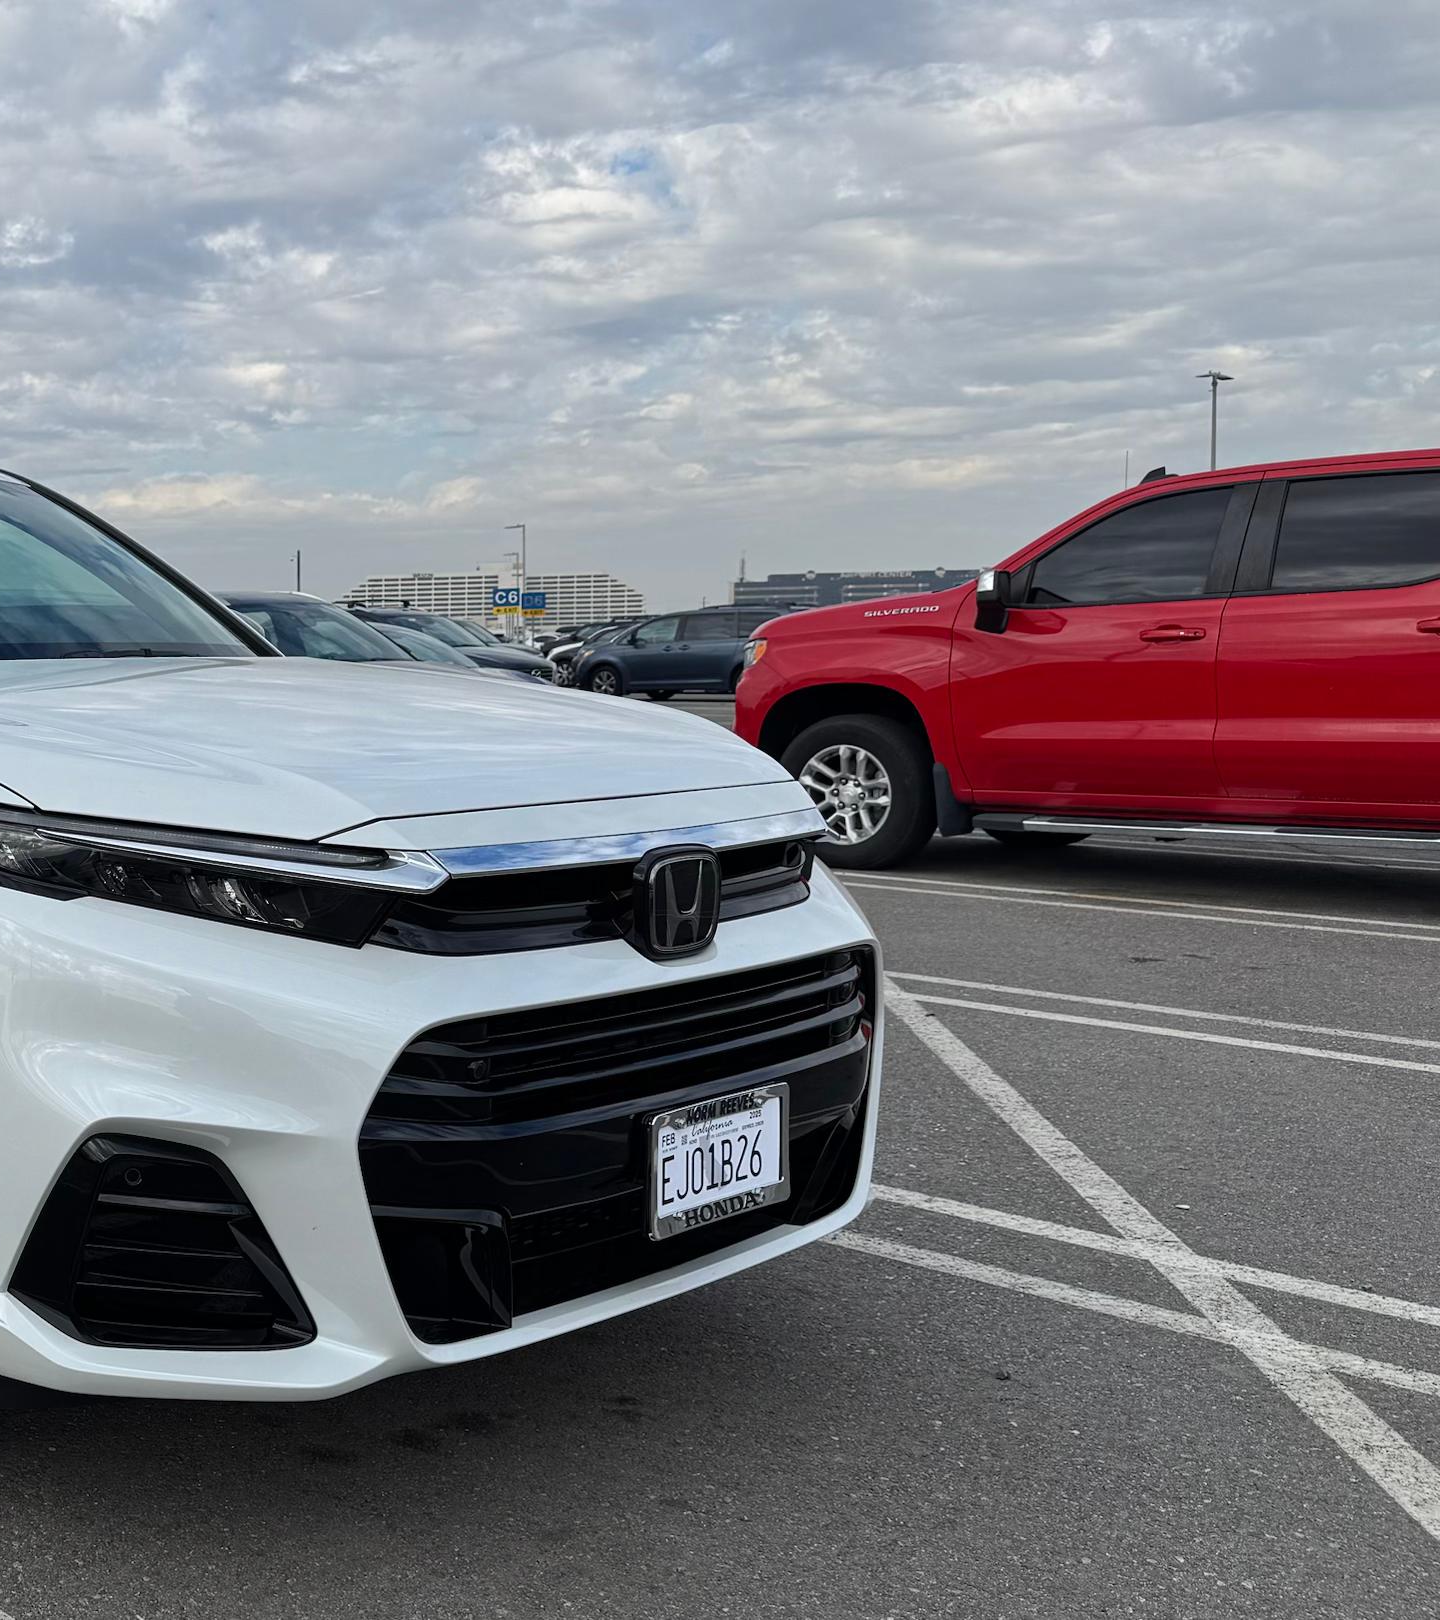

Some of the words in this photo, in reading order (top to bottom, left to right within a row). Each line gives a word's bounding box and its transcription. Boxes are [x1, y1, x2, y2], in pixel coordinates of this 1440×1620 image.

[495, 591, 518, 604] C6
[863, 605, 940, 617] SILVERADO
[686, 1101, 716, 1126] NORM
[719, 1092, 755, 1116] REEVES
[661, 1132, 676, 1148] FEB
[691, 1119, 733, 1141] California
[662, 1129, 762, 1206] EJ01B26
[684, 1190, 760, 1228] HONDA
